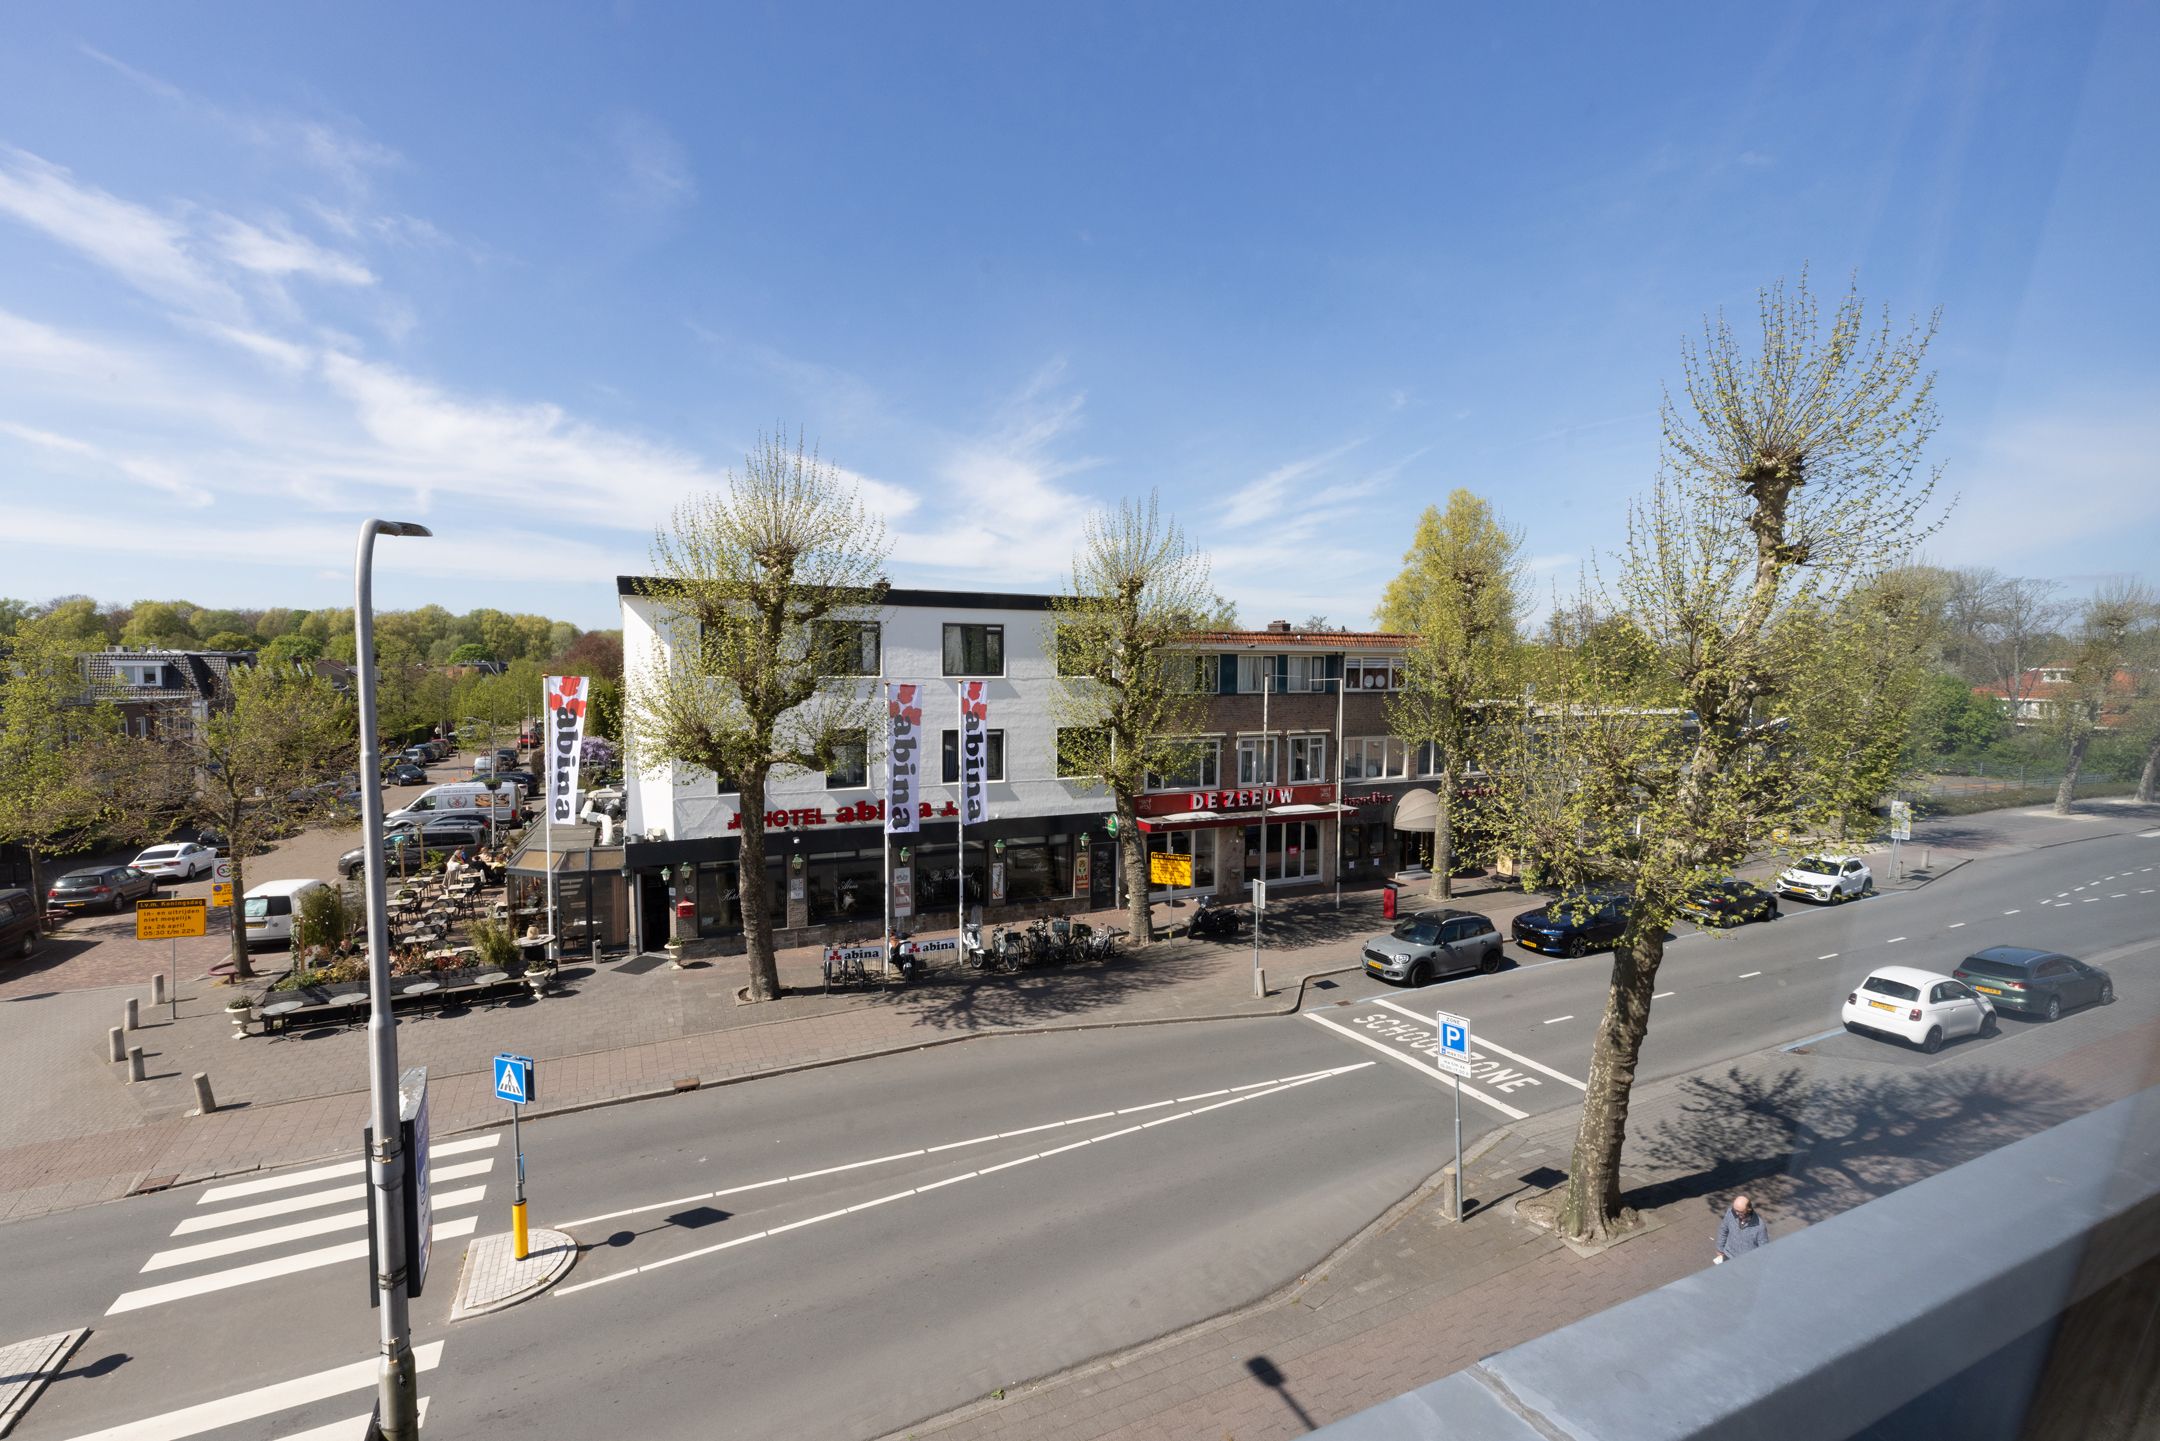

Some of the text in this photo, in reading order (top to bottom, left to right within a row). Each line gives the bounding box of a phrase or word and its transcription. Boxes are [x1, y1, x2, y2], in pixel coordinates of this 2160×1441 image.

[555, 706, 578, 821] abina
[891, 714, 917, 830] abina
[965, 710, 984, 822] abina
[1191, 788, 1294, 810] DE ZEEUW
[764, 799, 933, 828] HOTEL abia
[844, 949, 879, 960] abina
[922, 941, 955, 952] abina
[1446, 1017, 1460, 1025] ZONE
[1446, 1026, 1460, 1047] P
